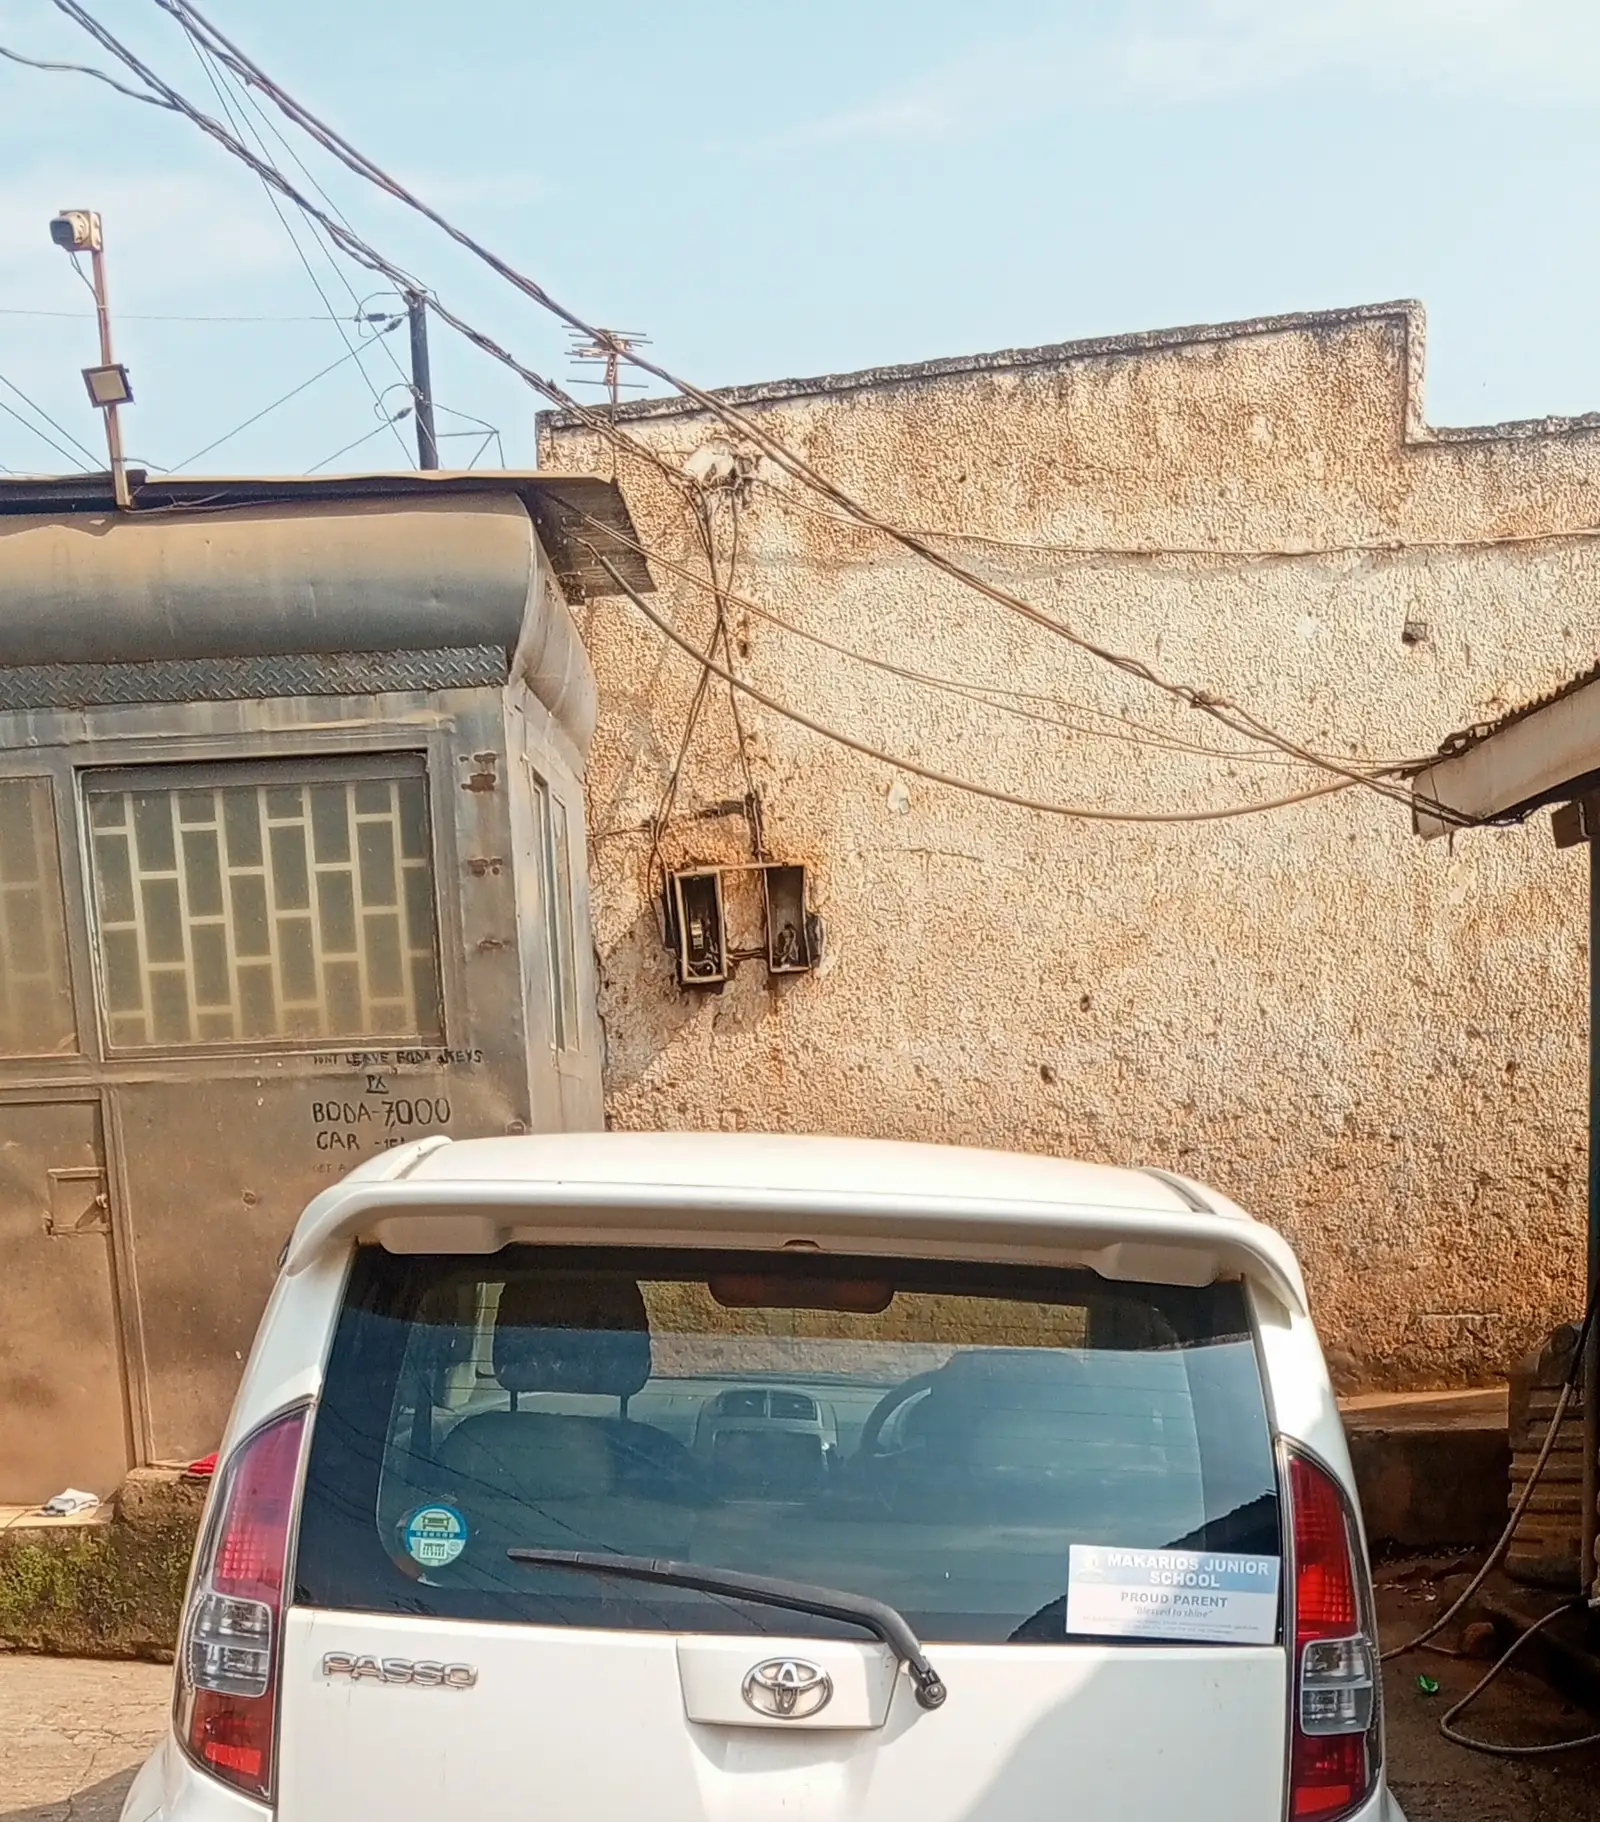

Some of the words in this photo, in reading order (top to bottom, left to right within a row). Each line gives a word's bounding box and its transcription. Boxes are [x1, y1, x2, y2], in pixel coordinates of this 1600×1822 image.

[316, 1131, 360, 1150] CAR
[1107, 1553, 1199, 1571] MAKARIOS
[1204, 1560, 1269, 1575] JUNIOR
[1150, 1572, 1221, 1588] SCHOOL
[1120, 1591, 1169, 1605] PROUD
[1173, 1596, 1228, 1608] PARENT
[322, 1651, 478, 1689] PASSO
